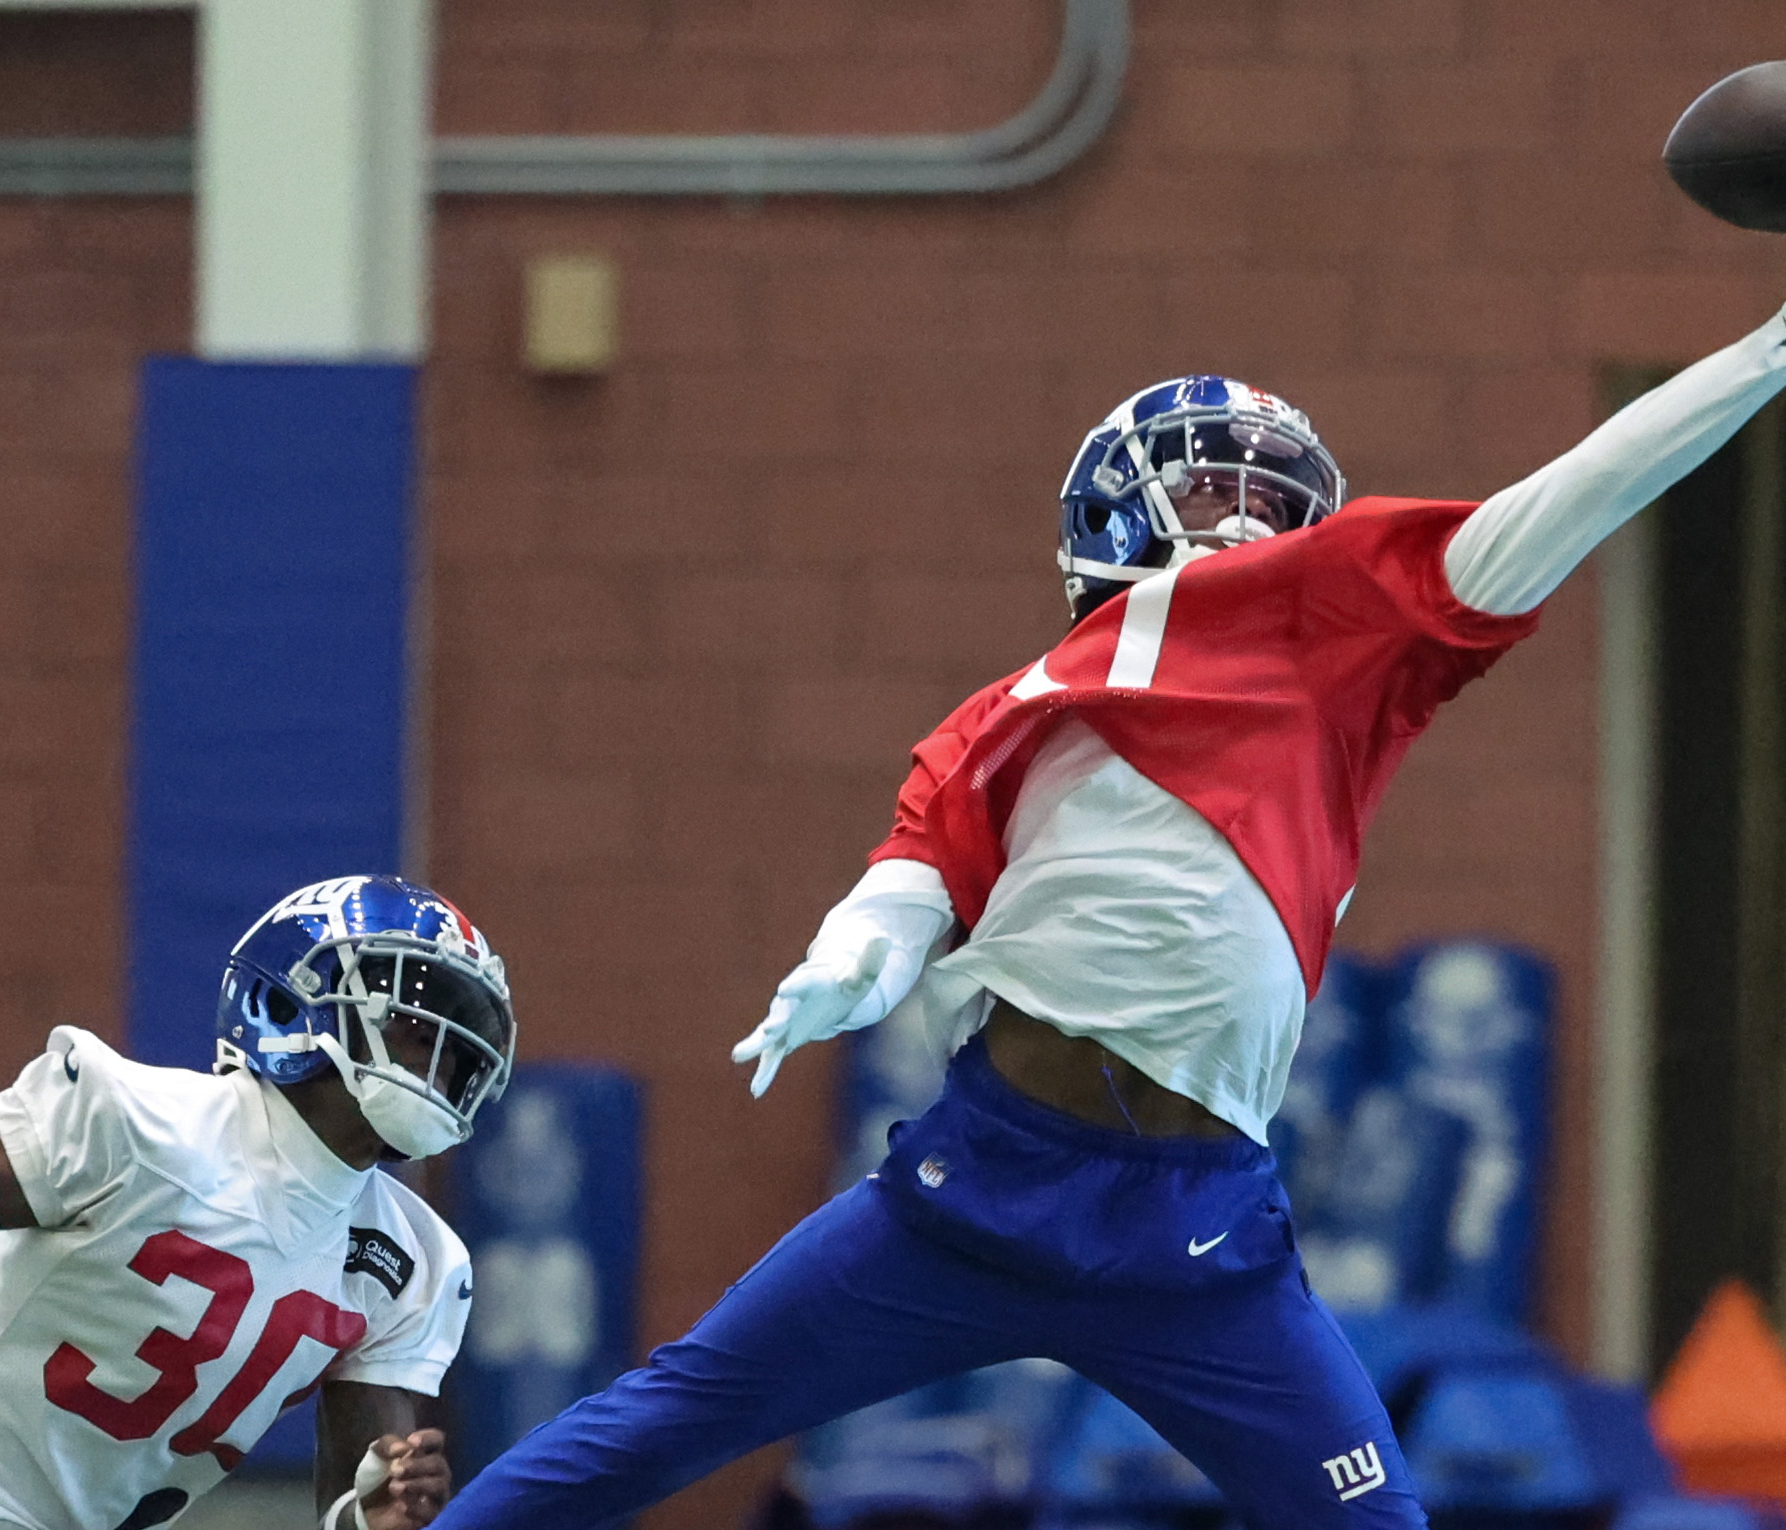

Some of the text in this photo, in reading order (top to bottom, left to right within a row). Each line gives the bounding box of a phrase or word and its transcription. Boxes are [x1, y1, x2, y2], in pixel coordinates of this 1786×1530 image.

[365, 1240, 401, 1271] Quest
[44, 1229, 367, 1473] 30
[1321, 1441, 1386, 1502] ny
